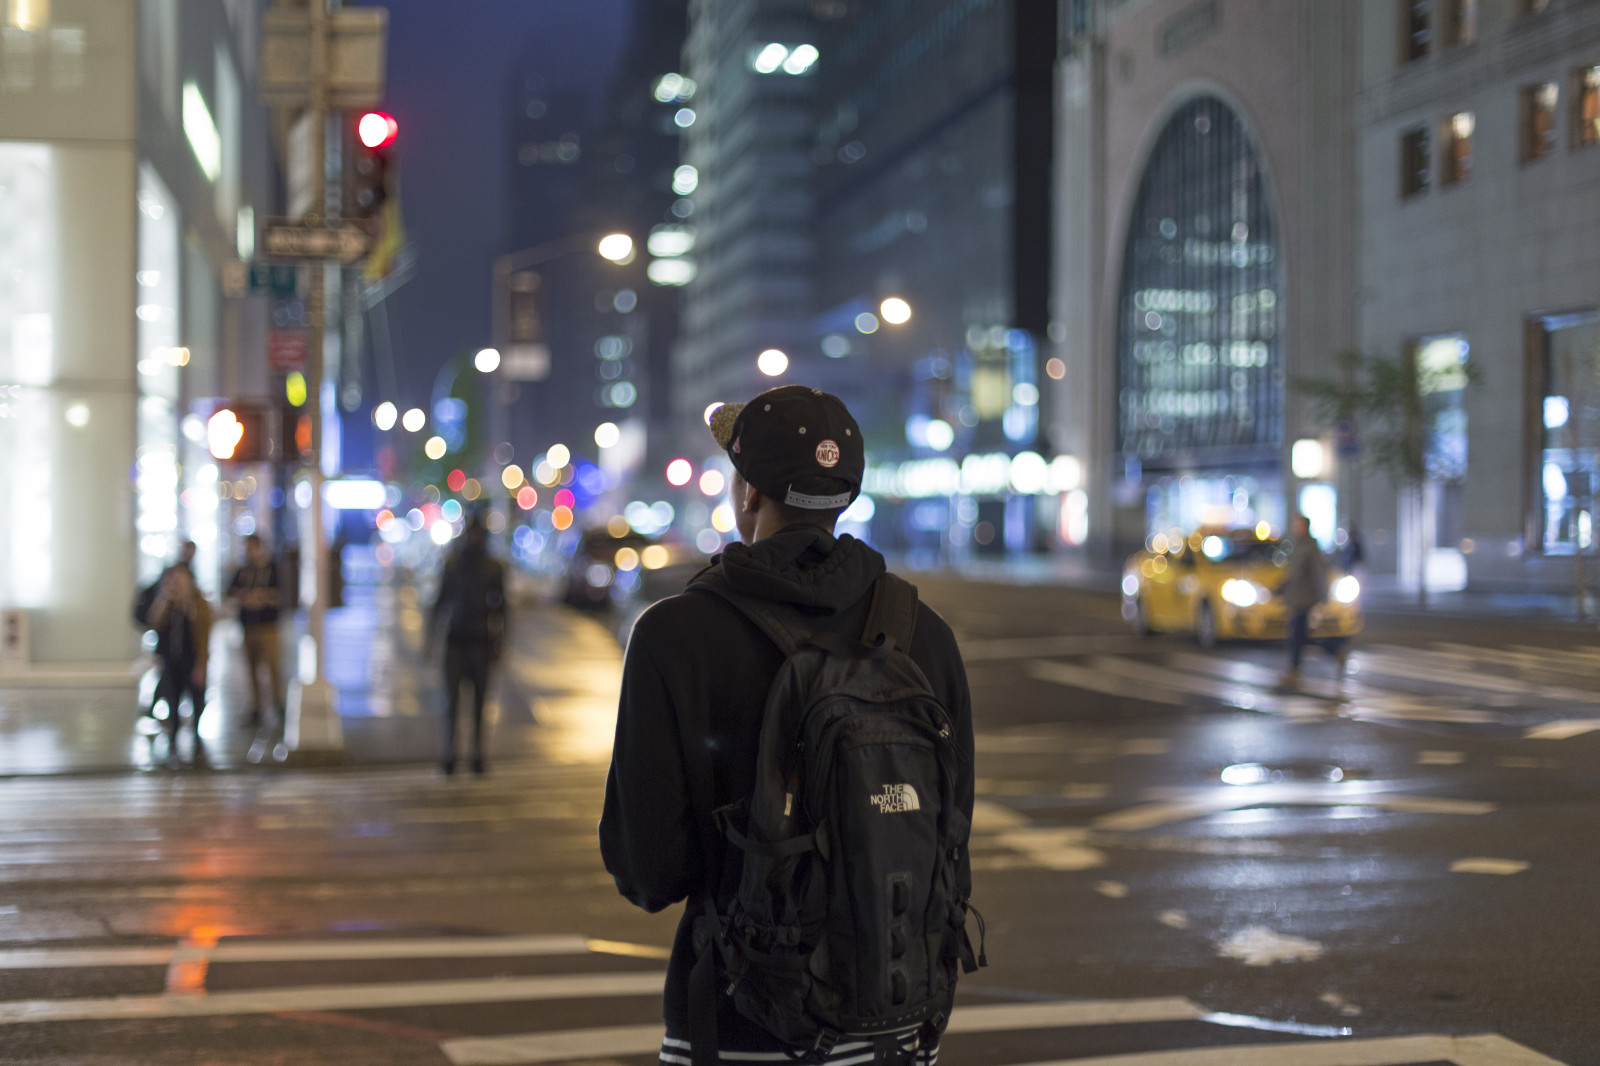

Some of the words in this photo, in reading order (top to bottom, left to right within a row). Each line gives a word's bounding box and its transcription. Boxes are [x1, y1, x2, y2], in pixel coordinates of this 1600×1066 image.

[882, 784, 903, 795] THE
[870, 793, 903, 805] NORTH
[880, 803, 903, 814] FACE
